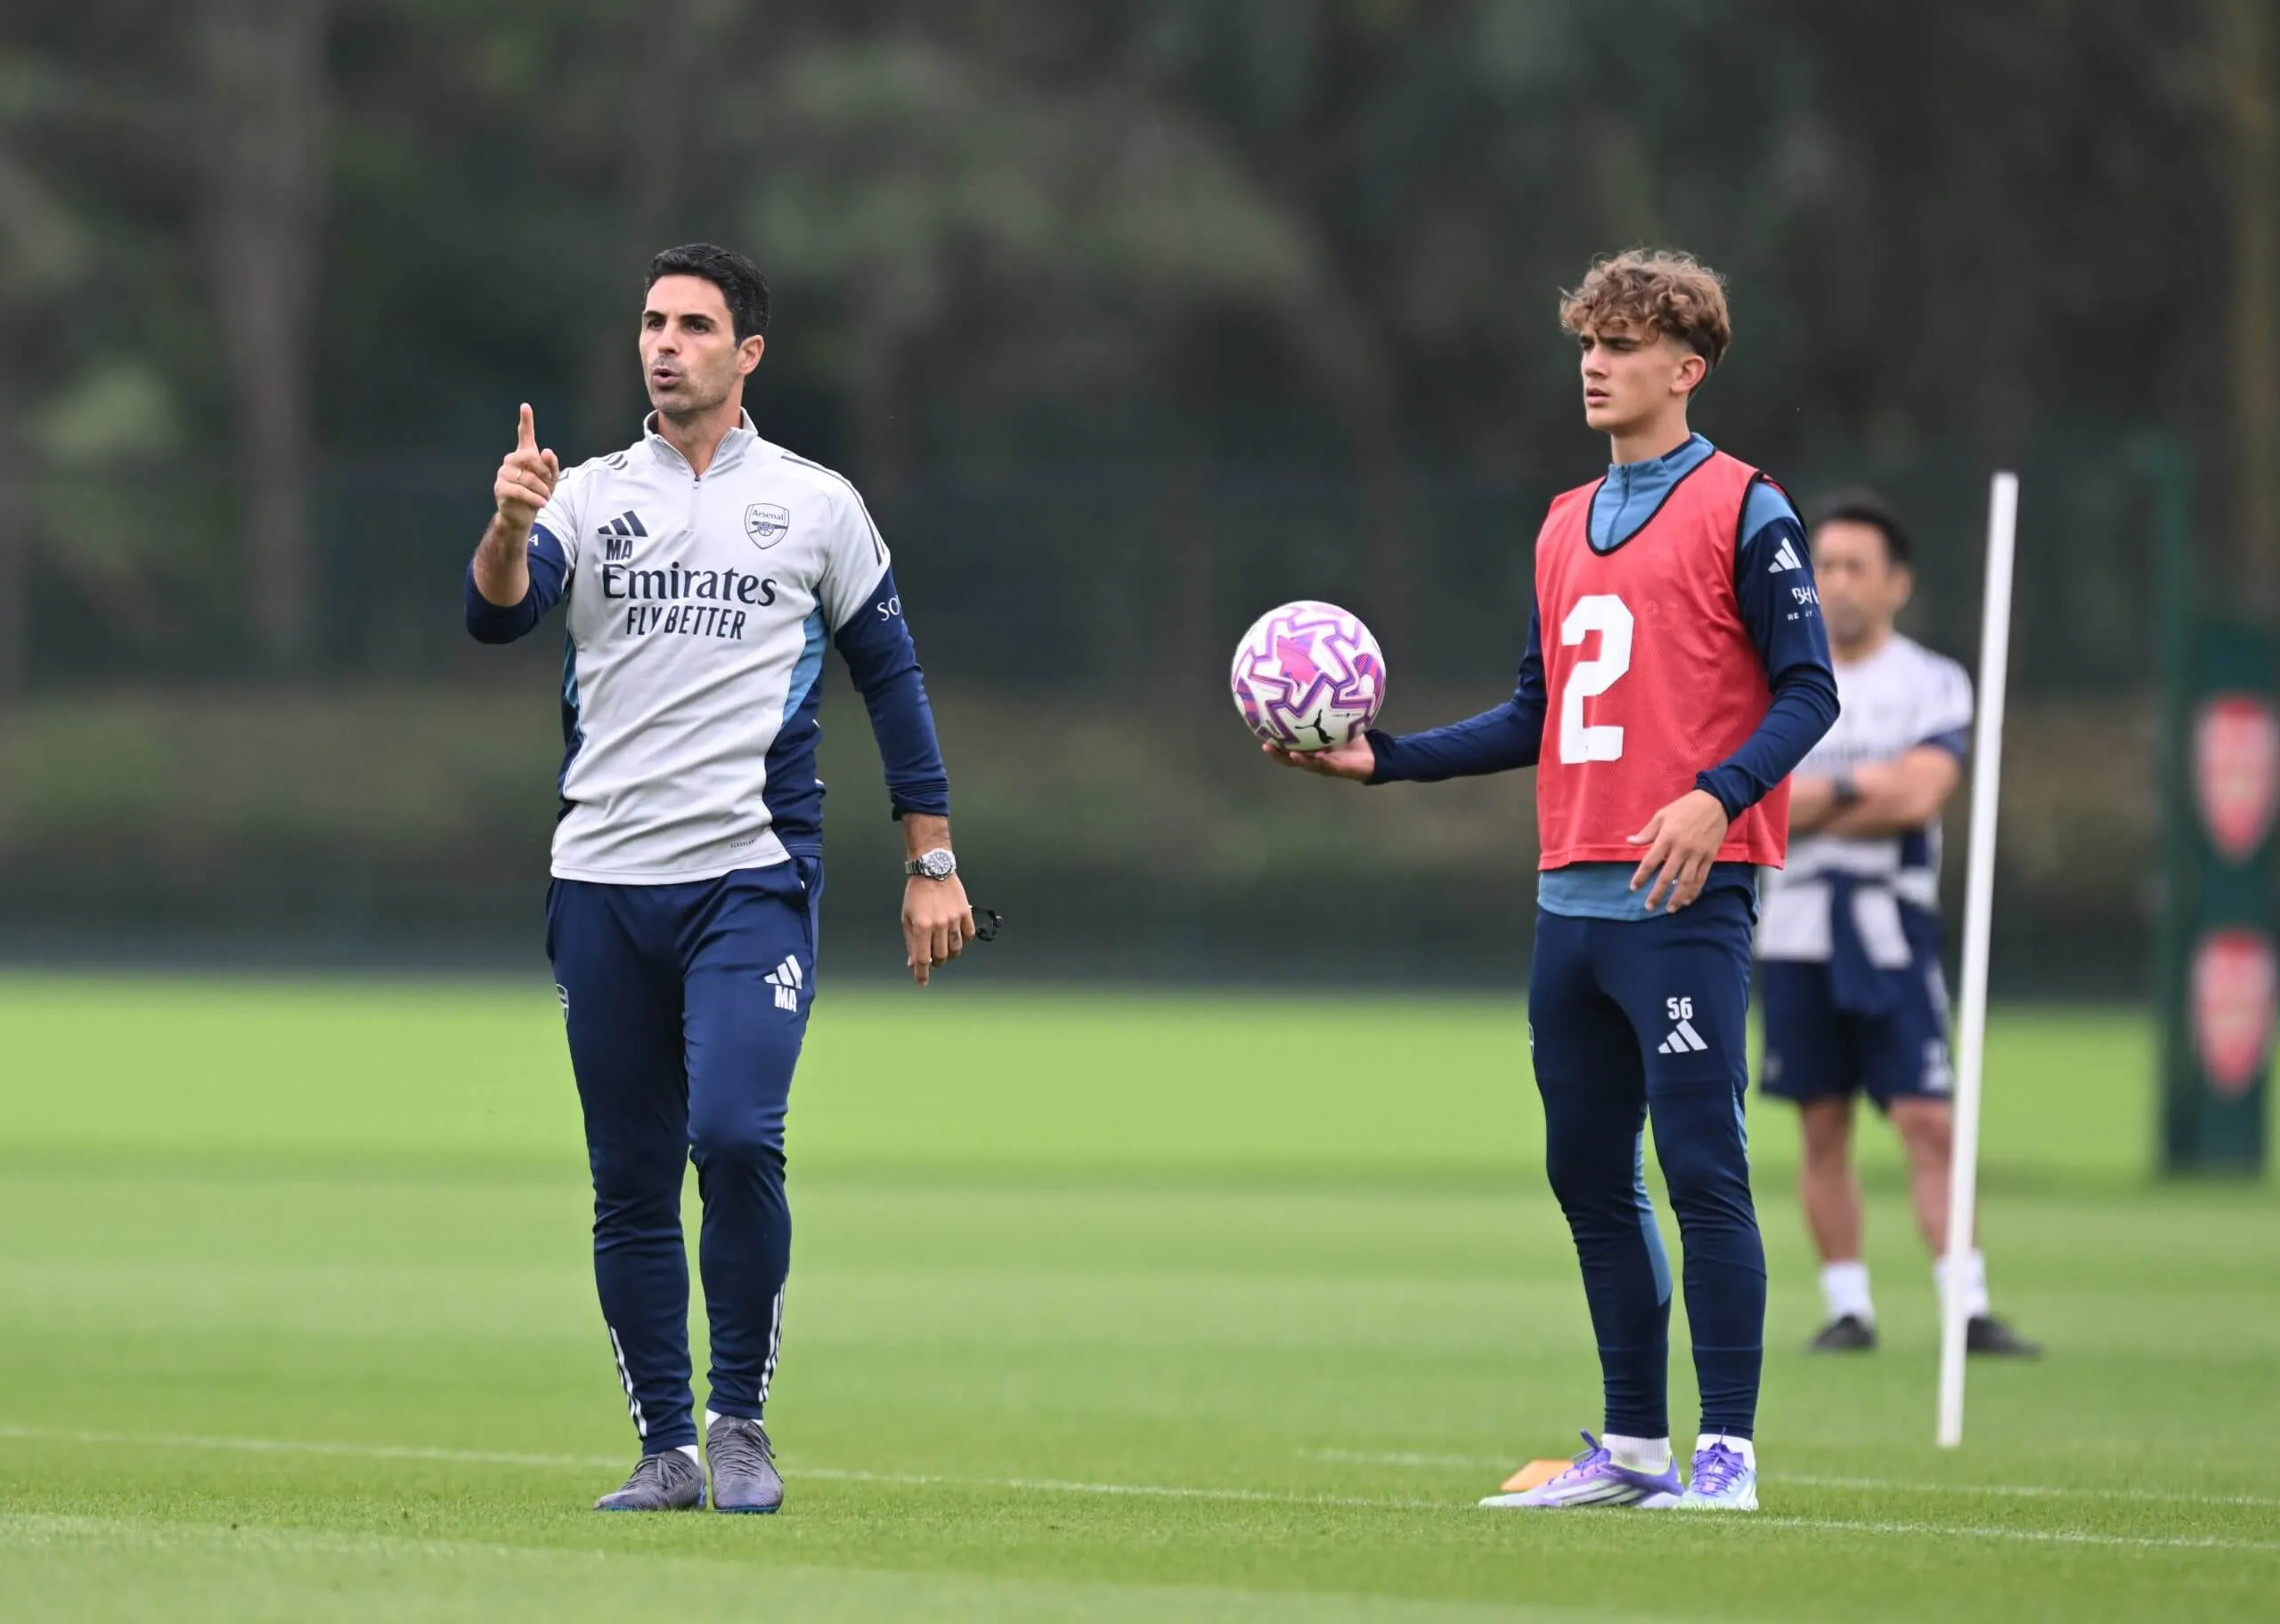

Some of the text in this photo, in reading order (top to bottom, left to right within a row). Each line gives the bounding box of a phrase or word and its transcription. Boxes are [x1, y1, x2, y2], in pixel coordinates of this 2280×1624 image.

[606, 538, 633, 561] MA
[602, 561, 778, 607] Emirates
[876, 595, 902, 621] SO
[626, 605, 747, 641] FLY BETTER
[1559, 594, 1635, 766] 2
[774, 984, 797, 1012] MA
[1666, 996, 1694, 1020] 56
